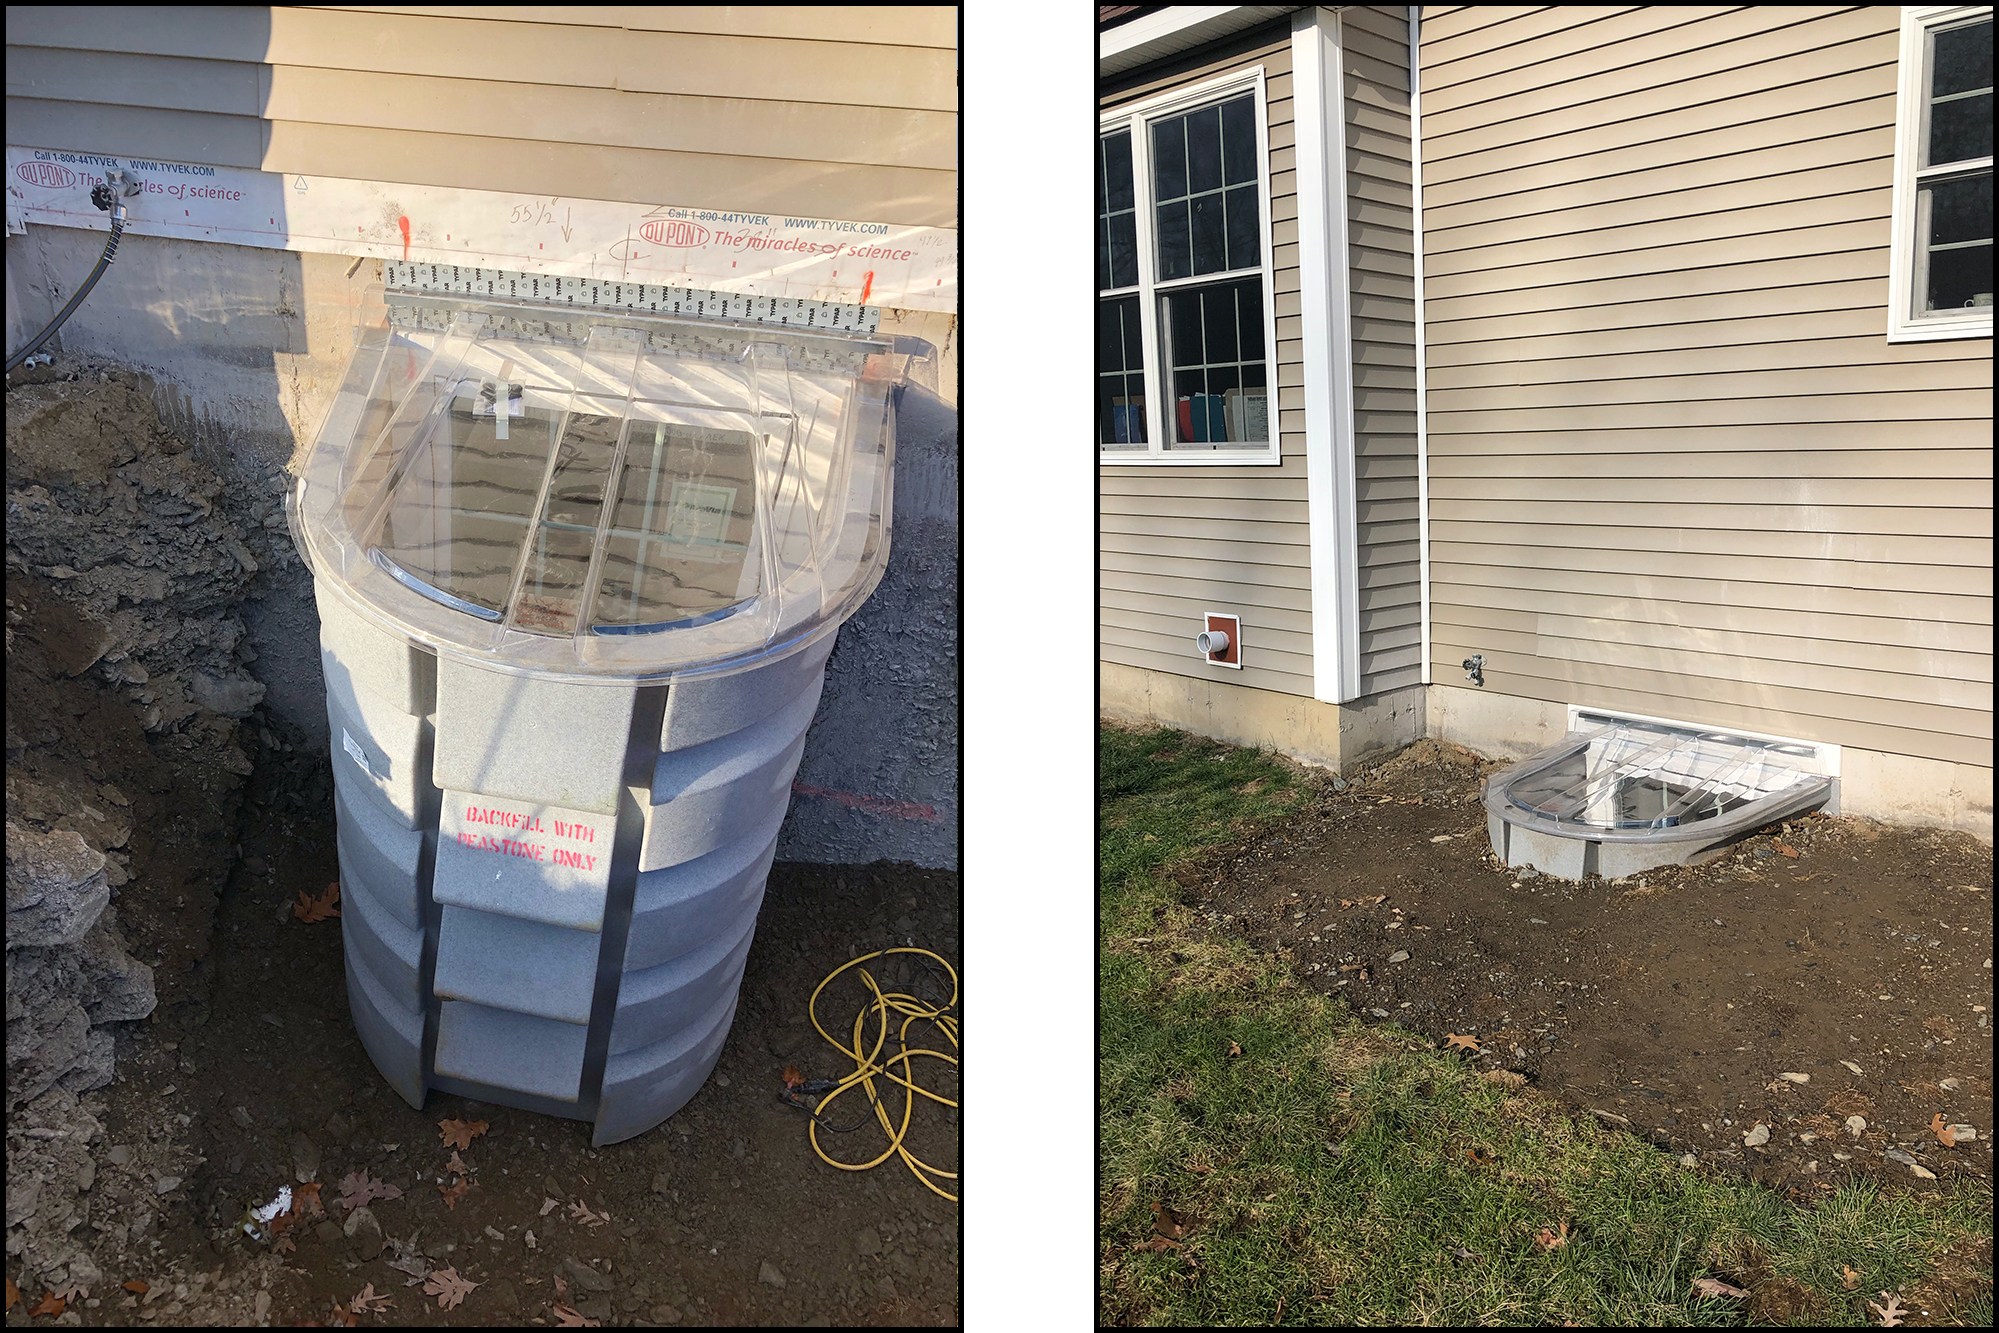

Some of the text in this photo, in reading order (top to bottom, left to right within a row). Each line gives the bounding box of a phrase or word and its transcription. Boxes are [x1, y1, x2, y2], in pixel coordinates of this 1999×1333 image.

[34, 151, 215, 177] Call 1-800-44TYVEK WWW.TYVEK.COM
[79, 172, 102, 186] The
[168, 185, 187, 200] of
[190, 187, 241, 201] science
[668, 208, 889, 235] Call 1-800-44TYVEK WWW.TYVEK.COM
[714, 231, 911, 262] The miracles of science
[388, 266, 396, 285] TYPAR
[409, 265, 417, 284] TYPAR
[807, 307, 816, 326] TYPAR
[832, 307, 841, 326] TYPAR
[857, 306, 866, 325] TYPAR
[466, 806, 595, 843] BACKFILL WITH
[457, 832, 597, 871] PEASTONE ONLY
